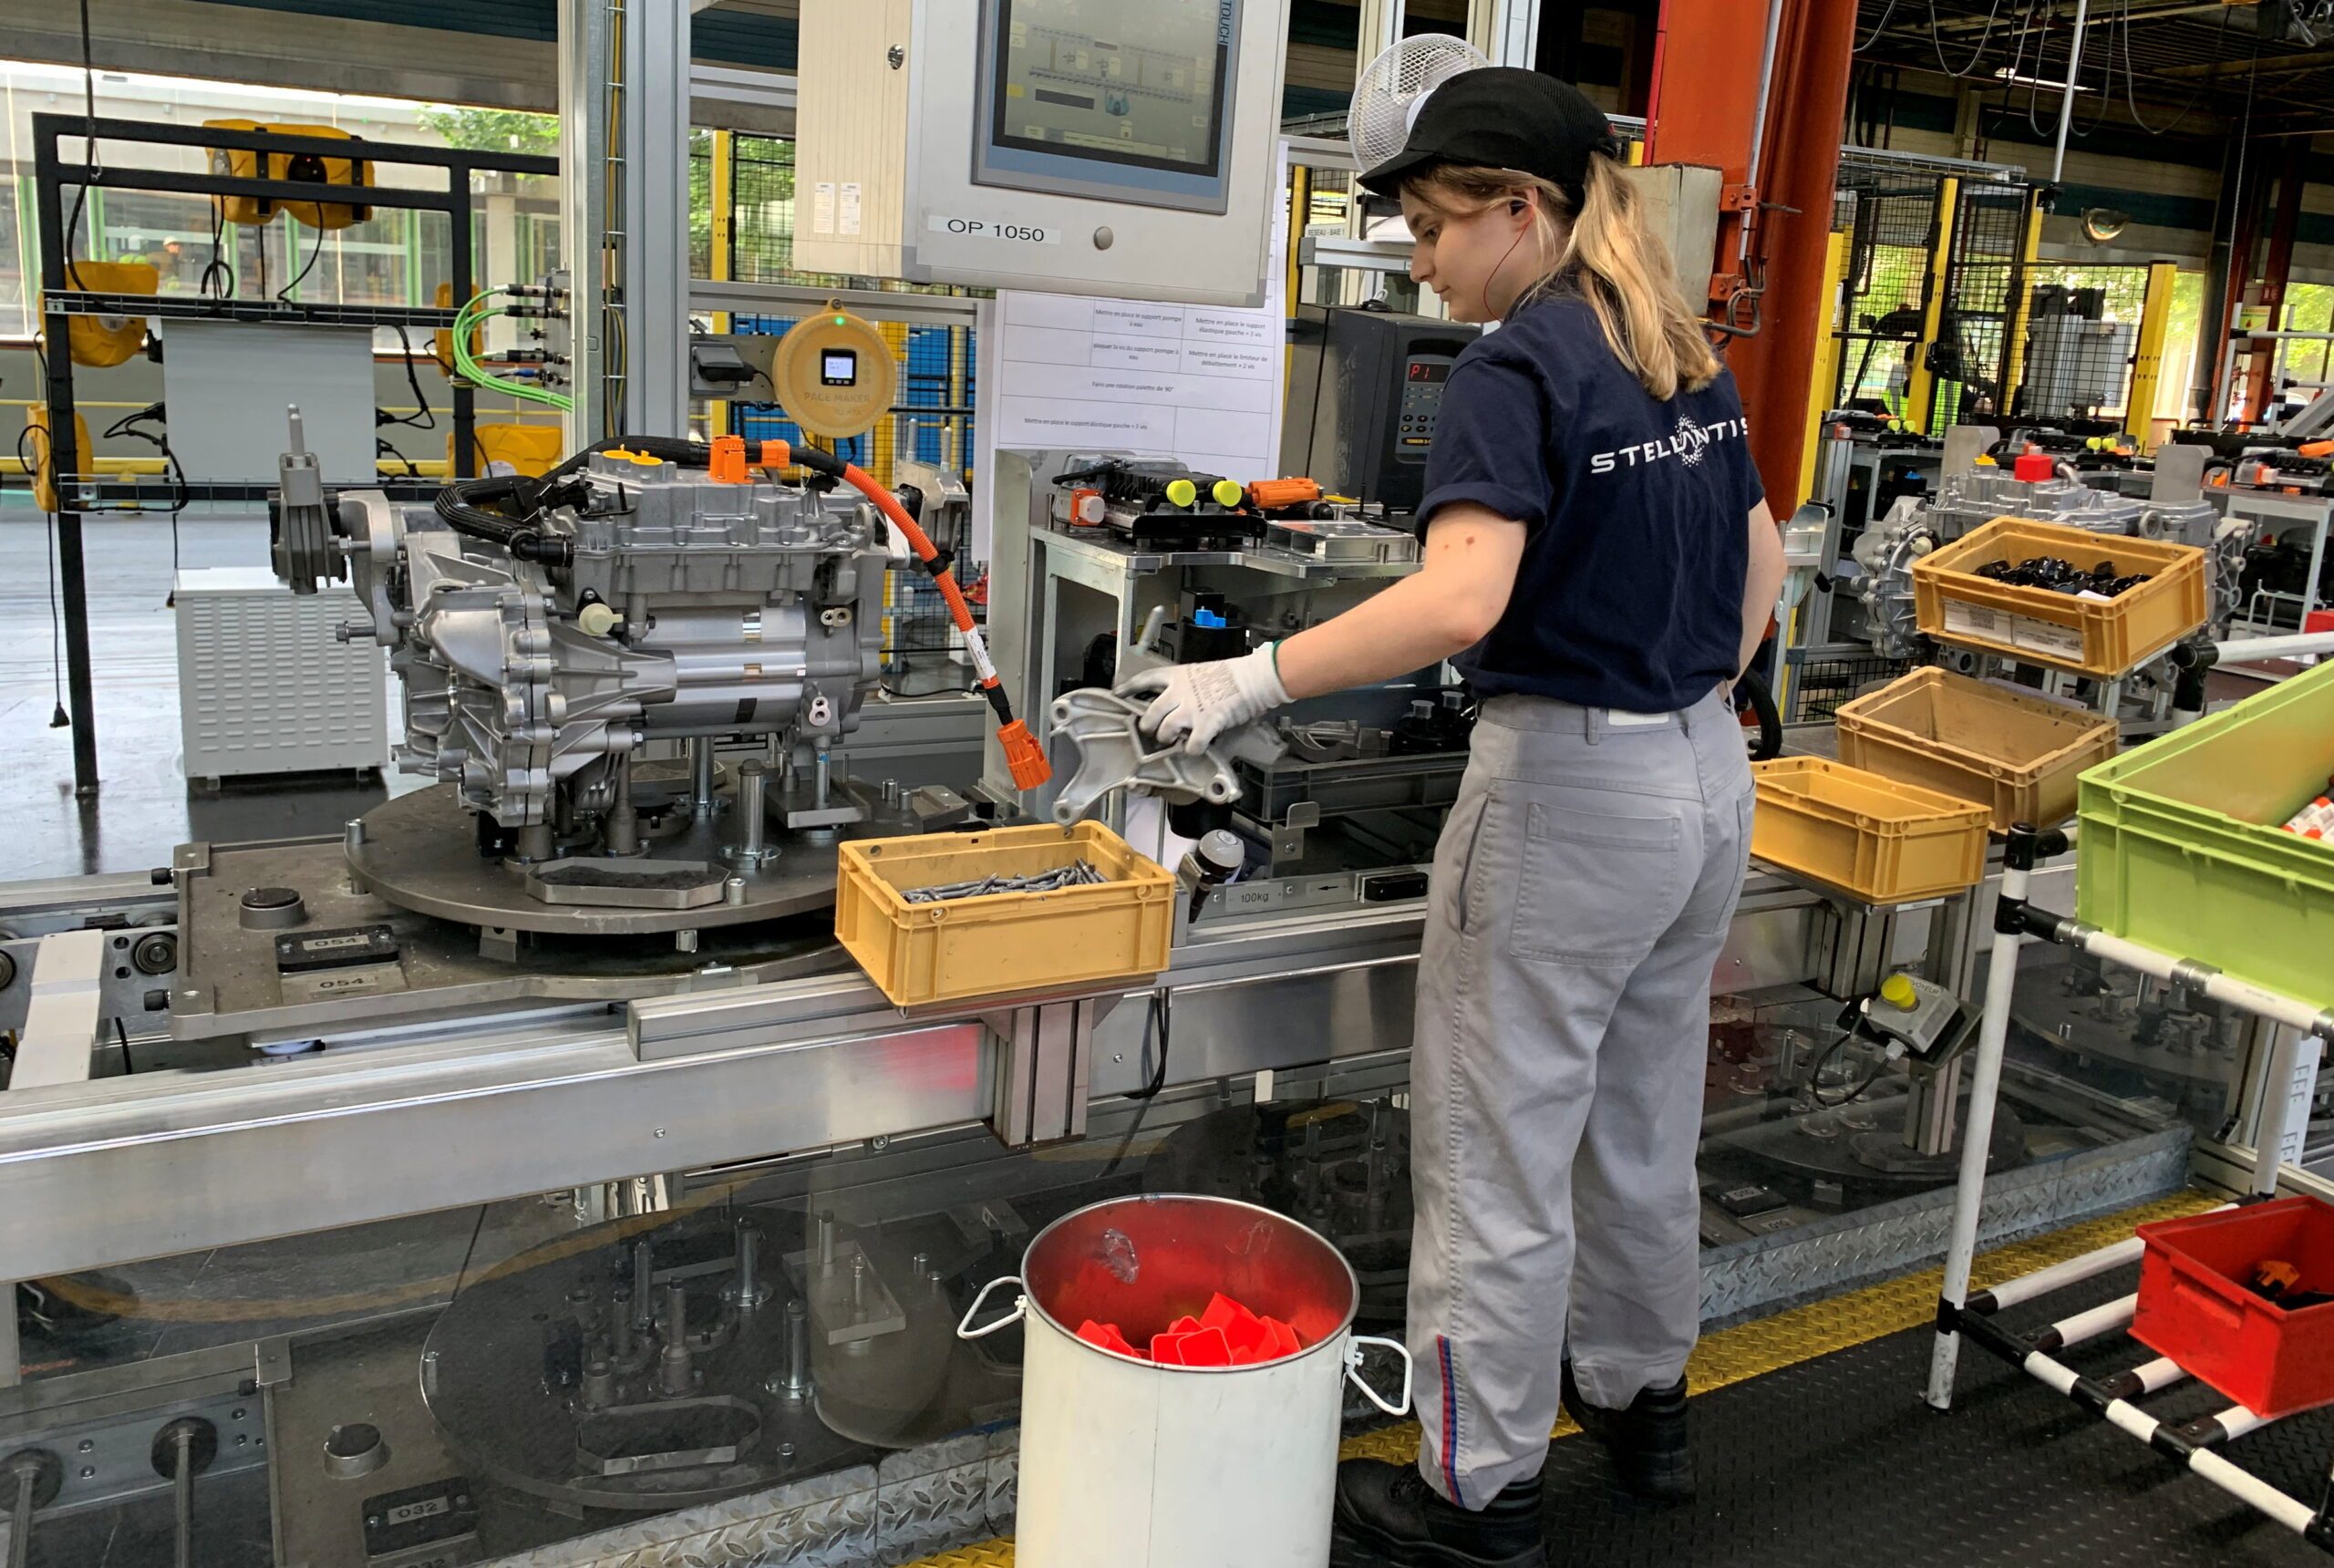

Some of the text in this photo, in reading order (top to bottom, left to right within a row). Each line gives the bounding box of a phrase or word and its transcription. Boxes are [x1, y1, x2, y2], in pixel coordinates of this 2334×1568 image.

[1219, 0, 1232, 45] TOUCH
[947, 219, 1045, 242] OP 1050
[1217, 352, 1232, 360] place
[803, 392, 871, 403] PACE MAKER
[1241, 892, 1269, 903] 100kg
[315, 937, 358, 947] 054
[319, 977, 365, 988] 054
[1909, 979, 1943, 995] VOYEUR
[398, 1501, 438, 1518] 032
